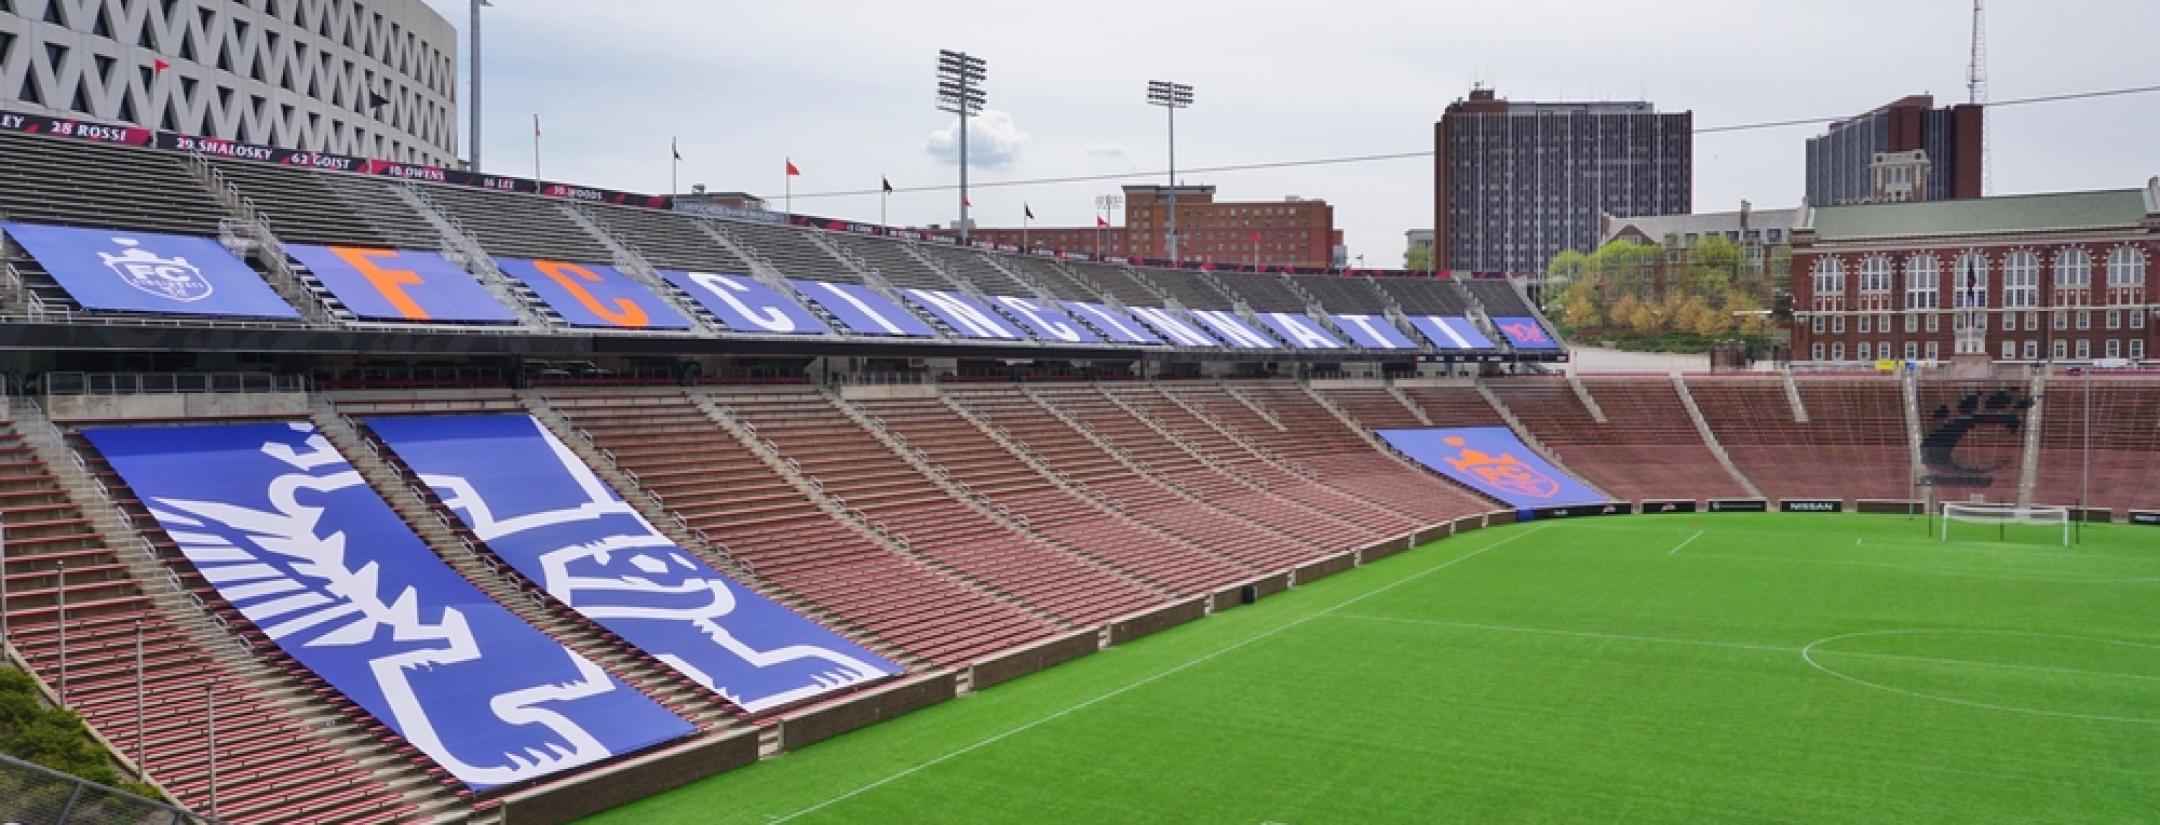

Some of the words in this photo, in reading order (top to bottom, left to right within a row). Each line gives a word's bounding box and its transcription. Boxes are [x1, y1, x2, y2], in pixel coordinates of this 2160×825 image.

[51, 121, 73, 134] 28
[77, 124, 127, 141] ROSSI
[198, 139, 273, 161] SHALOSKY
[314, 154, 351, 169] GOIST
[125, 264, 190, 281] FC
[1790, 502, 1832, 512] NISSAN
